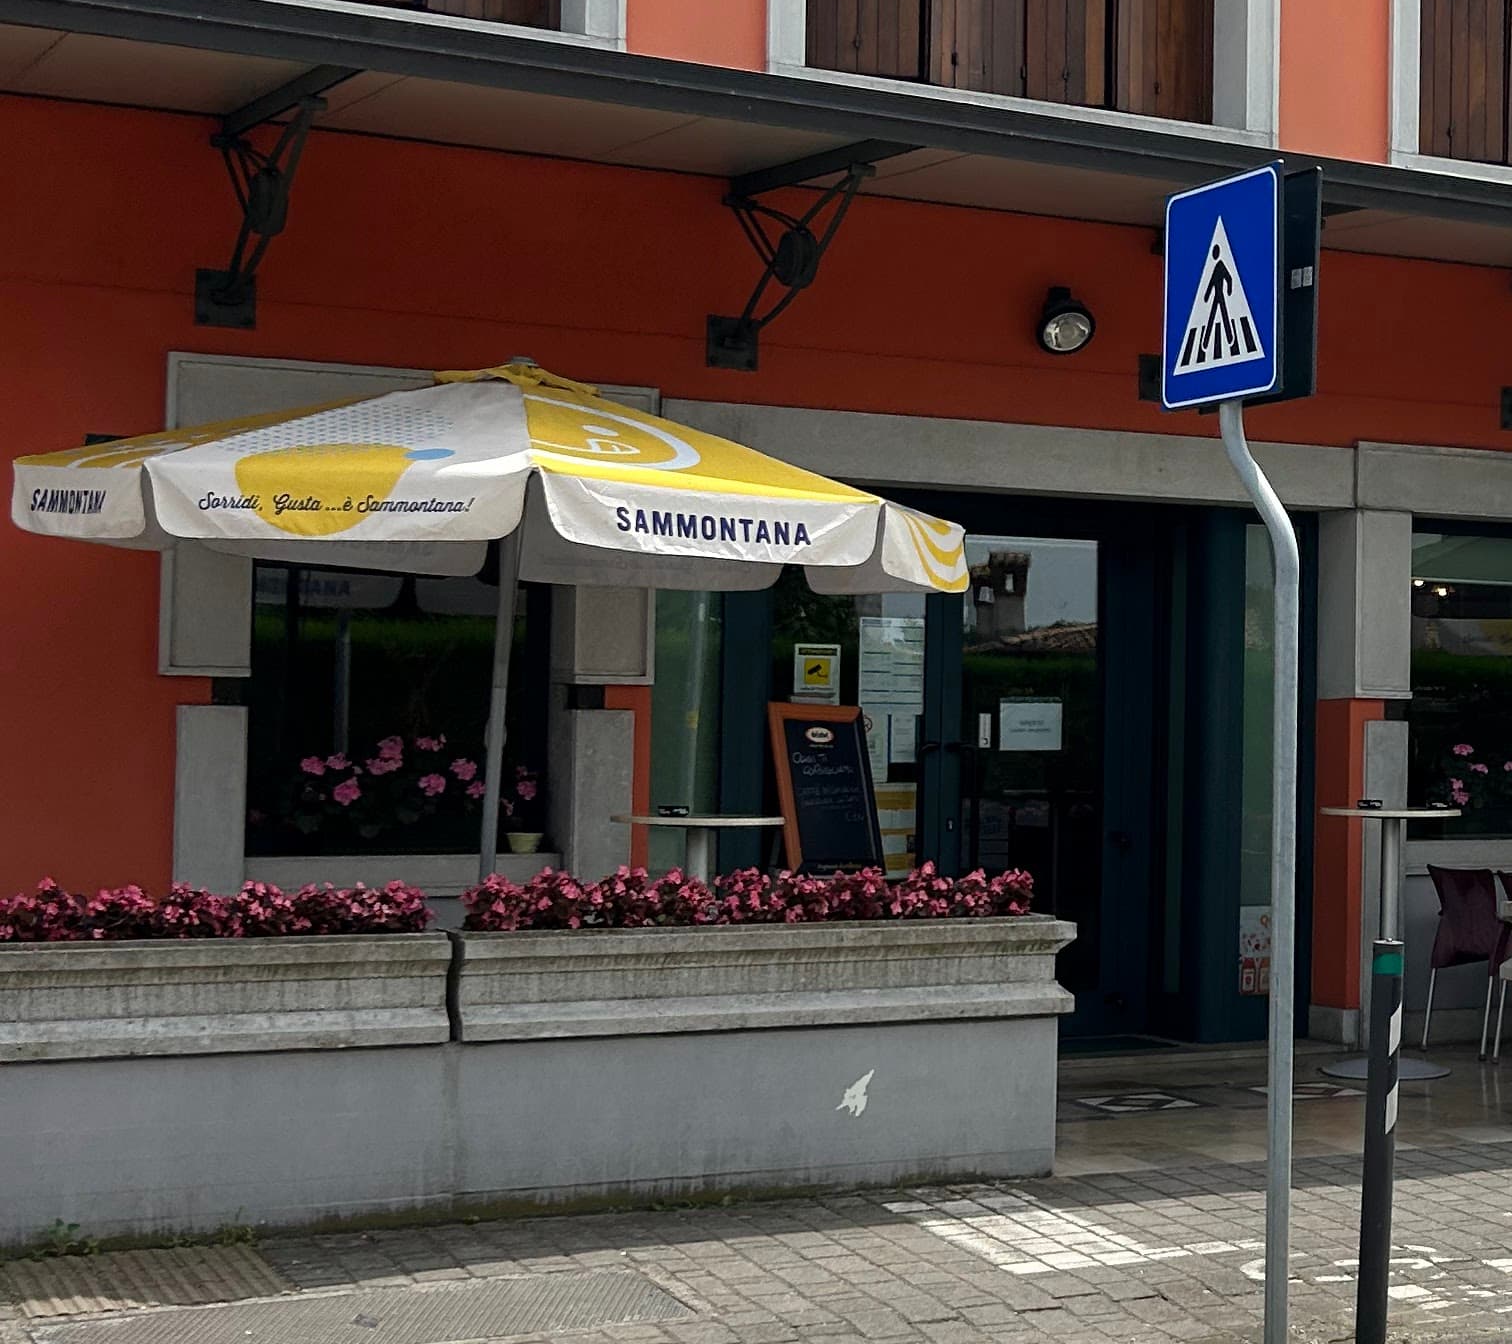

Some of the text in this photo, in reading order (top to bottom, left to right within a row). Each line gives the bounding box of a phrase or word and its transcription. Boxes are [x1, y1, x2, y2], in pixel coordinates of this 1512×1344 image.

[199, 491, 262, 511] Sorridi,
[273, 494, 322, 515] Gusta
[357, 494, 476, 513] Sammontana!
[616, 506, 811, 545] SAMMONTANA
